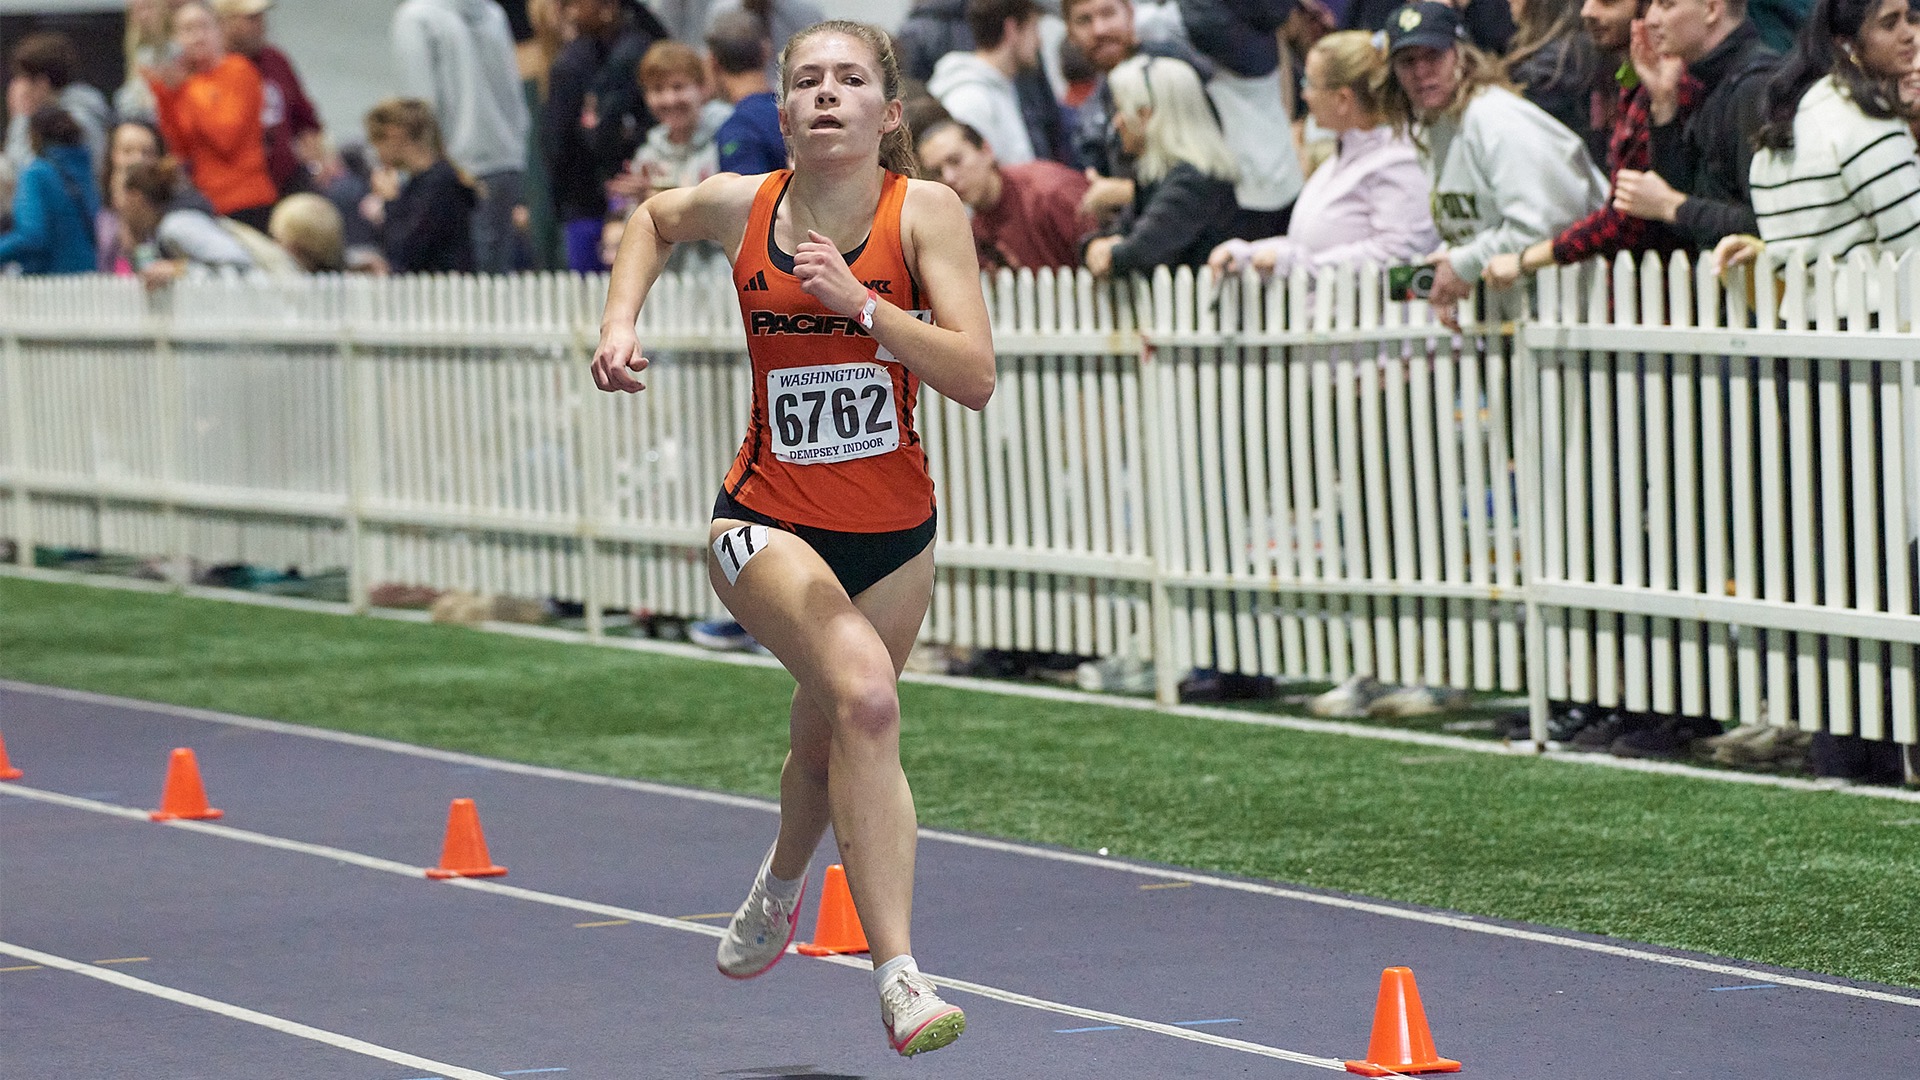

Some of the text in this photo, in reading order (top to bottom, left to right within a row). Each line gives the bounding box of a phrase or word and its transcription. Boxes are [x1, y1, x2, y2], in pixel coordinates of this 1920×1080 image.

[750, 310, 871, 338] PACIFI
[780, 367, 876, 388] WASHINGTON
[775, 384, 893, 447] 6762
[789, 445, 840, 460] DEMPSEY
[843, 437, 884, 454] INDOOR
